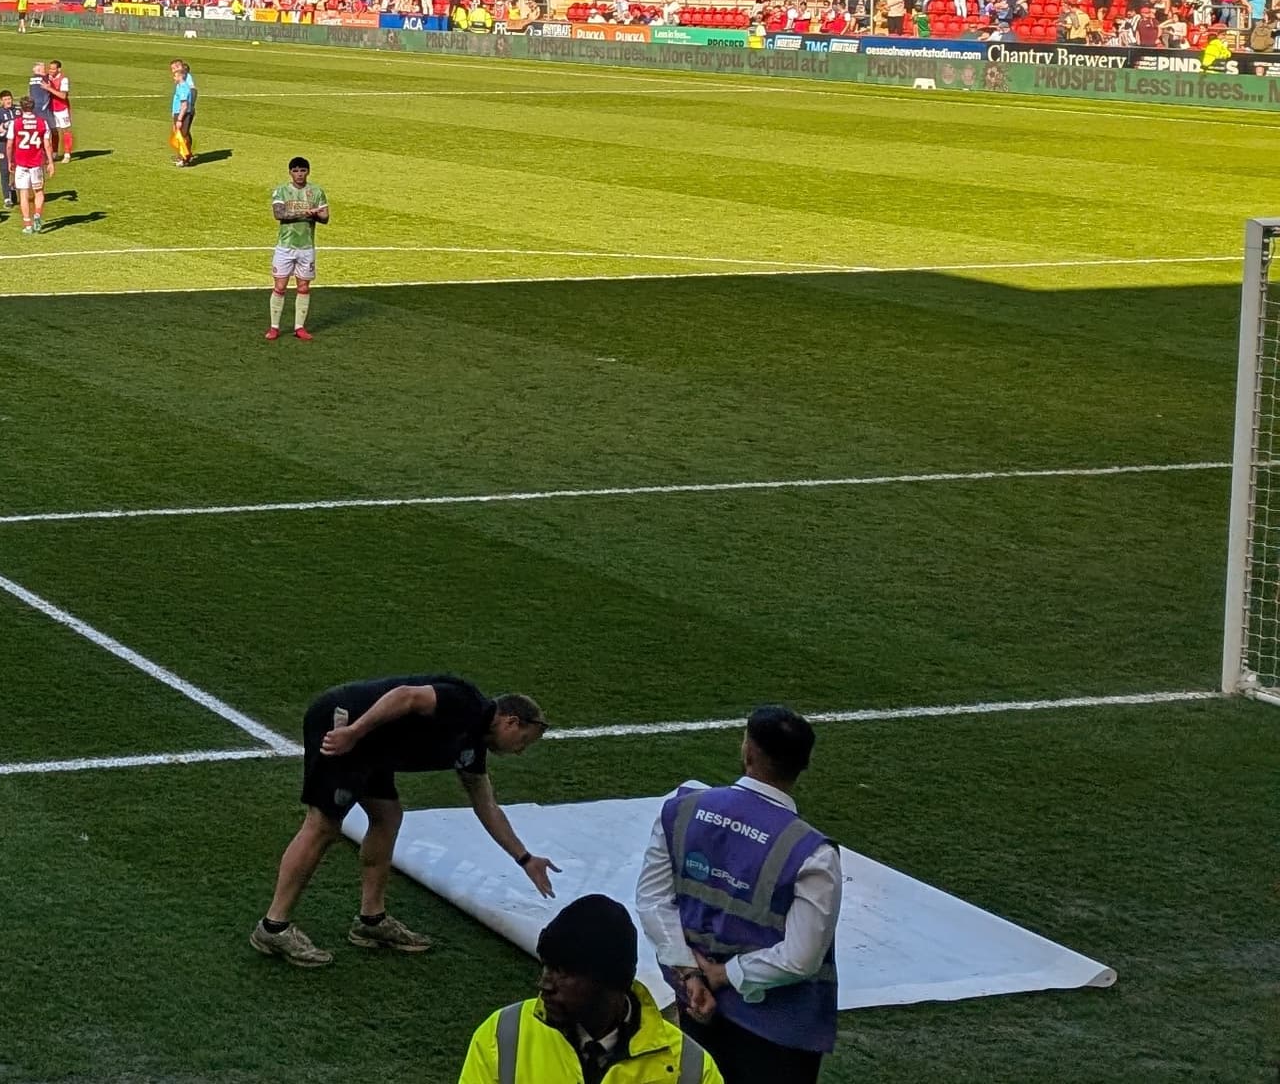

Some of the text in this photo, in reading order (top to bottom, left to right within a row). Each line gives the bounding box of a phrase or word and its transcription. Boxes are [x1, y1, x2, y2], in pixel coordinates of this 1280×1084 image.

[403, 18, 423, 30] ACA
[426, 33, 468, 49] PROSPER
[576, 29, 606, 40] PUKKA
[615, 31, 645, 42] PUKKA
[527, 37, 574, 55] PROSPER
[579, 42, 606, 59] Less
[619, 44, 656, 62] fees...
[661, 49, 691, 64] More
[692, 51, 714, 66] for
[716, 54, 745, 70] you.
[748, 53, 799, 73] Capital
[805, 41, 828, 52] TMG
[988, 44, 1053, 65] Chantry
[1057, 48, 1128, 69] Brewery
[1158, 56, 1239, 75] PINDS
[867, 57, 938, 79] PROSPER
[1035, 67, 1264, 102] PROSPER Less in fees...
[18, 131, 42, 149] 24
[695, 809, 771, 845] RESPONSE
[711, 869, 750, 890] GROUP
